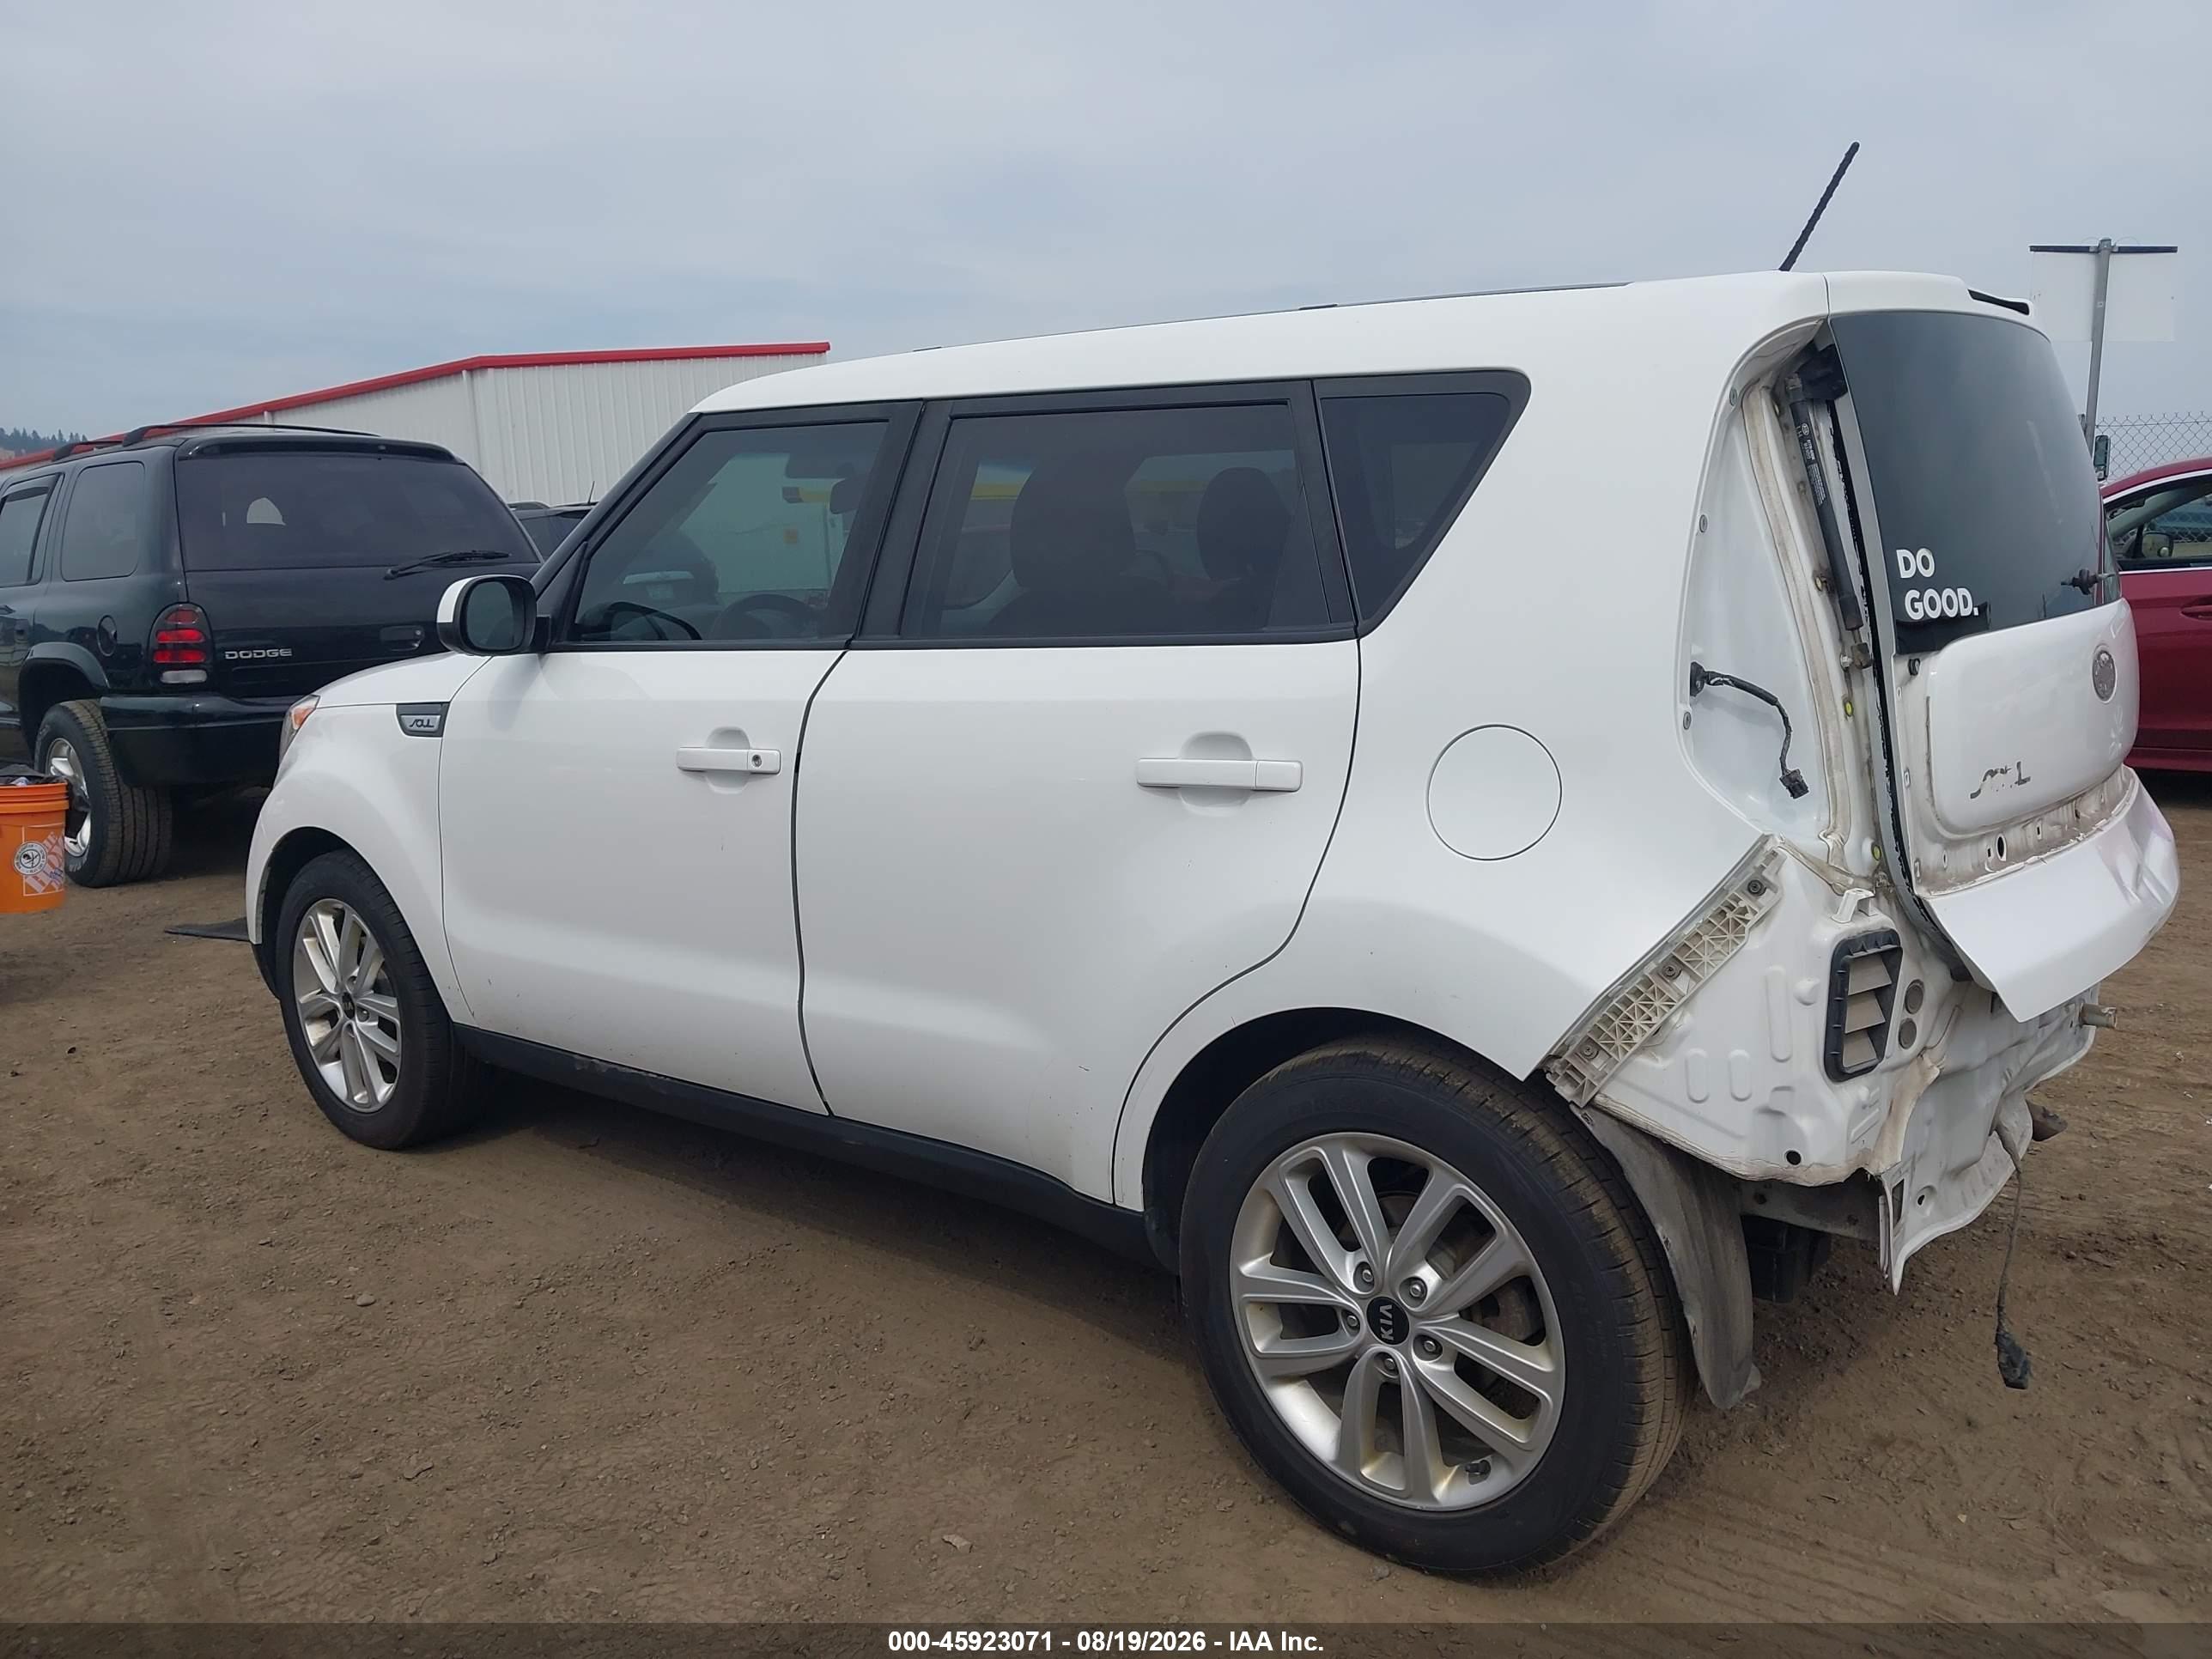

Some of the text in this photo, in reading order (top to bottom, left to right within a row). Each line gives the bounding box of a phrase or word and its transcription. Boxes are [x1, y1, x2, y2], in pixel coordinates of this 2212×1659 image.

[1896, 548, 1936, 579] DO
[1905, 587, 1979, 620] GOOD.
[224, 648, 293, 659] DODGE
[409, 718, 434, 728] SOUL
[1379, 1304, 1395, 1340] KIA
